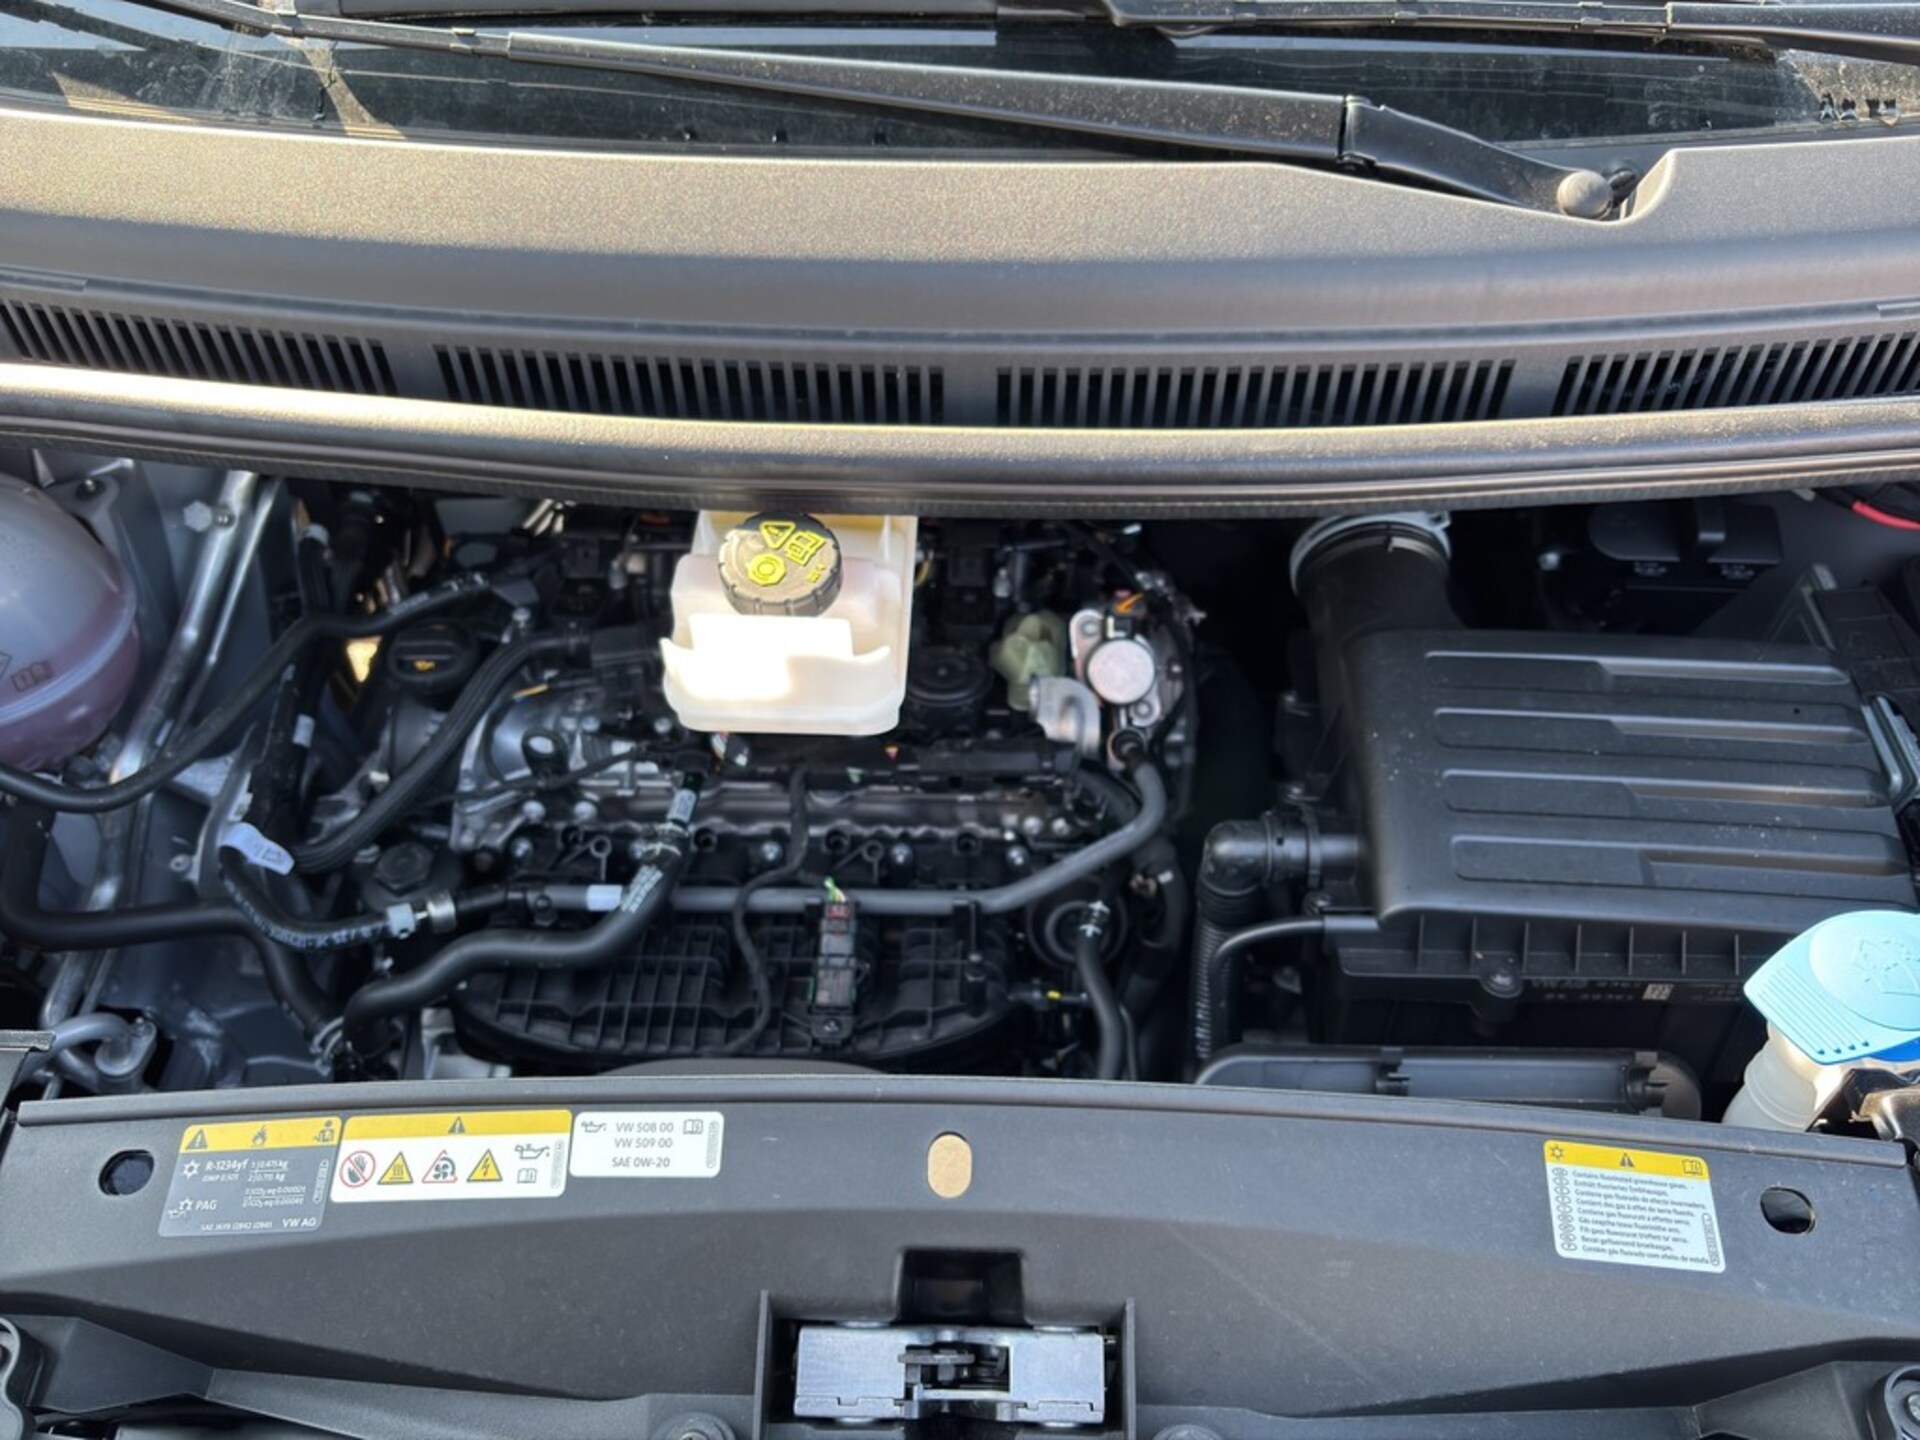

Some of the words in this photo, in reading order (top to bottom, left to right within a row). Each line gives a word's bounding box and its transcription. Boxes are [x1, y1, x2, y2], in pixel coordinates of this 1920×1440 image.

[616, 1122, 634, 1132] VW
[637, 1122, 657, 1132] 508
[659, 1122, 674, 1132] 00
[614, 1138, 633, 1148] VW
[635, 1138, 656, 1148] 509
[658, 1138, 673, 1148] 00
[612, 1157, 630, 1167] SAE
[633, 1157, 670, 1168] 0W-20
[195, 1200, 218, 1210] PAG
[282, 1218, 300, 1228] VW
